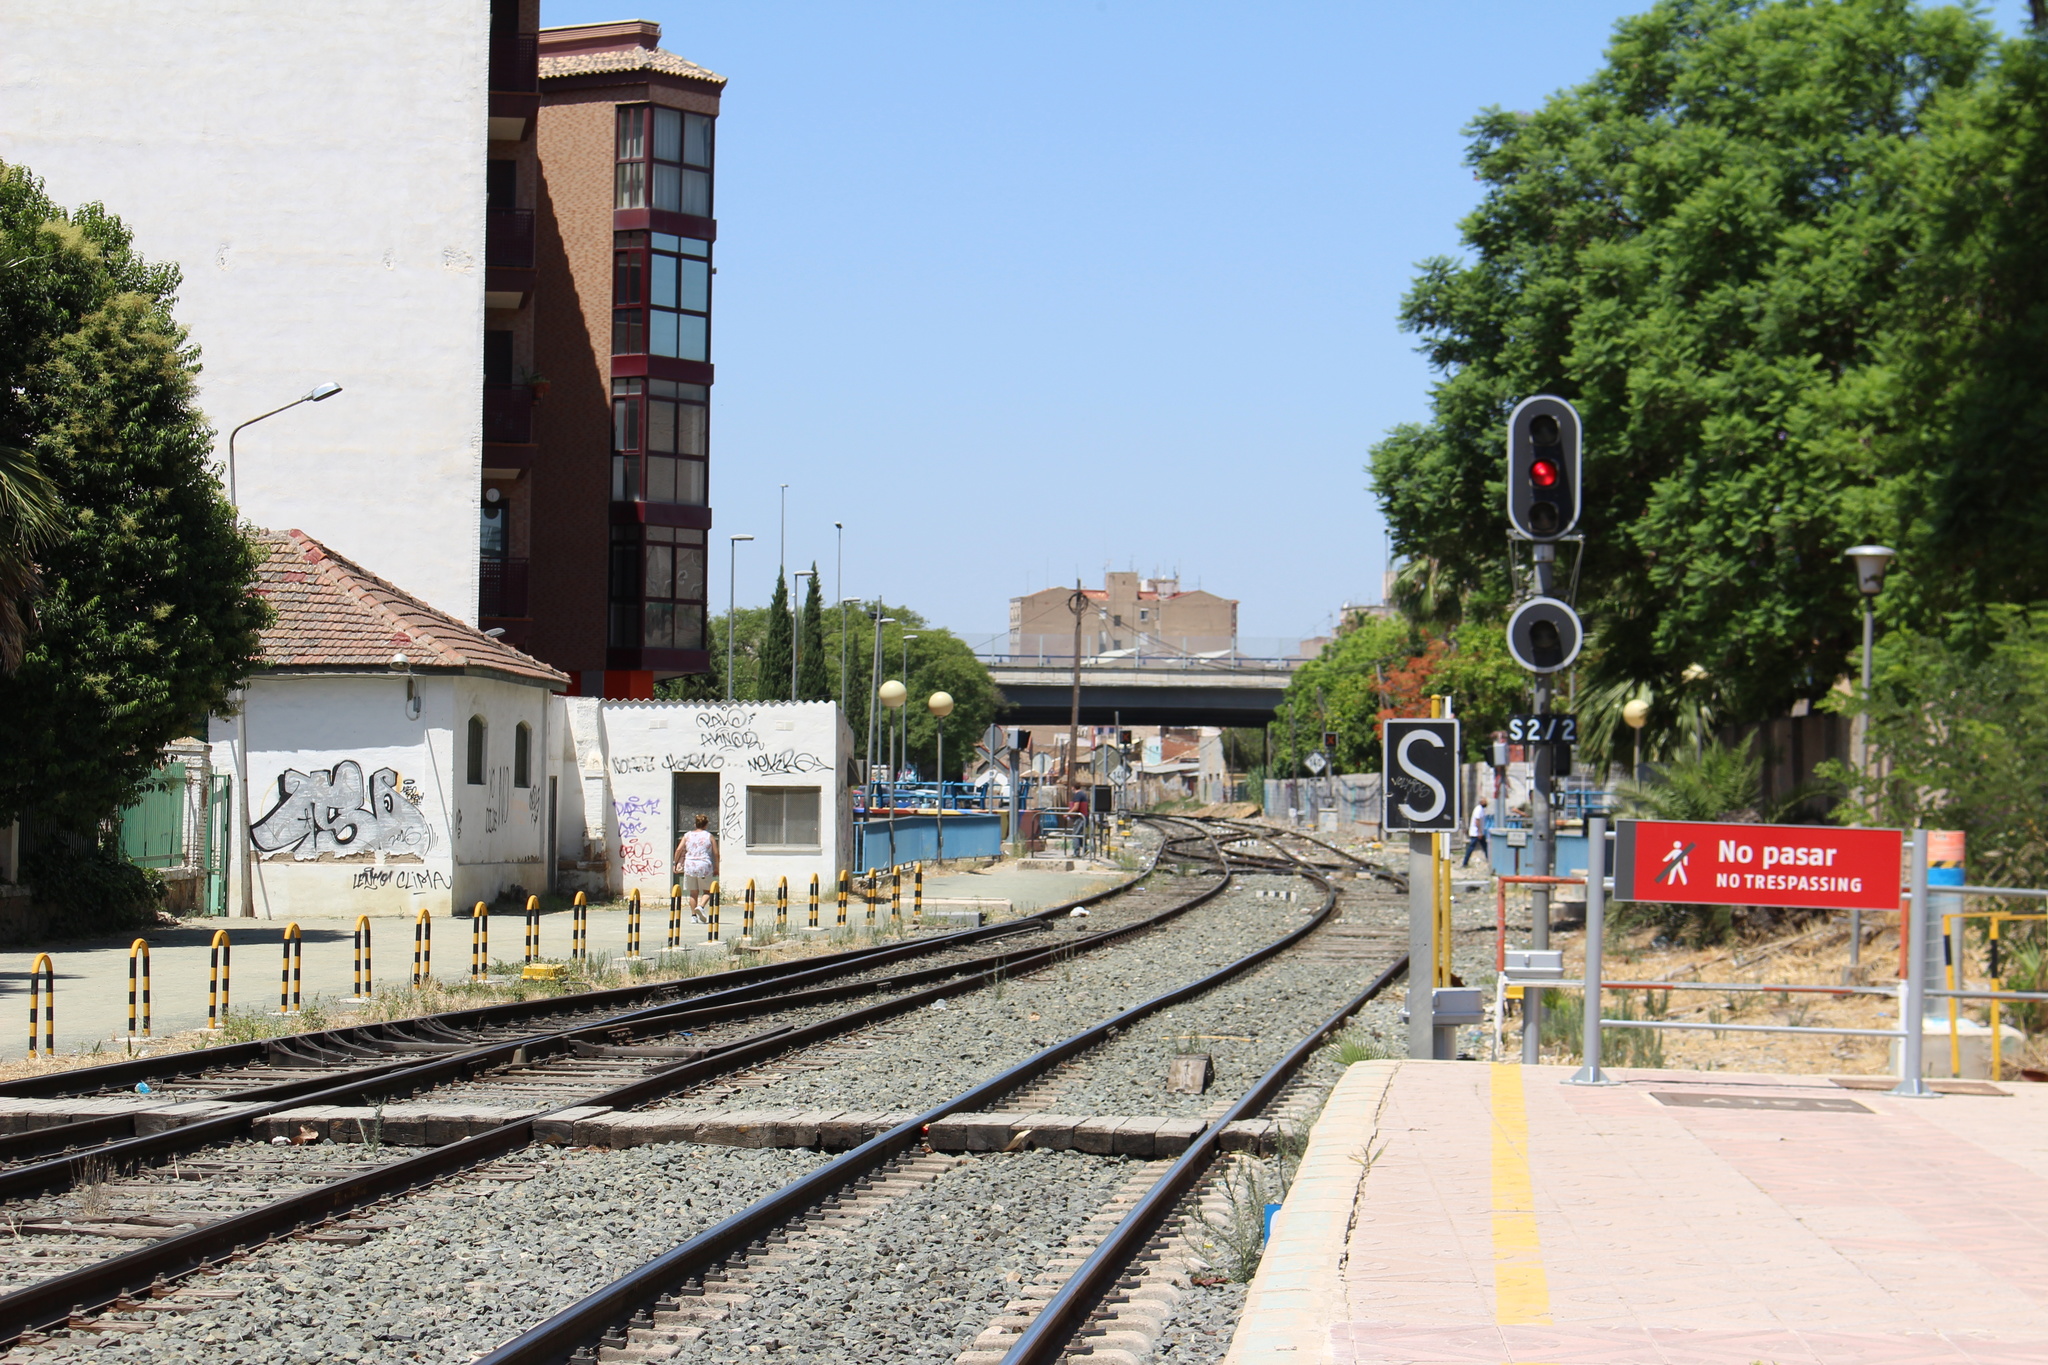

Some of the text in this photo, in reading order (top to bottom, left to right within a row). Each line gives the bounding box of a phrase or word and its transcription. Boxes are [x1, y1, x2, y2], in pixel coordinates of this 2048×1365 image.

[1509, 718, 1576, 741] S2/2
[1397, 728, 1446, 823] S
[1718, 840, 1838, 870] No pasar
[1716, 873, 1863, 893] NO TRESPASSING
